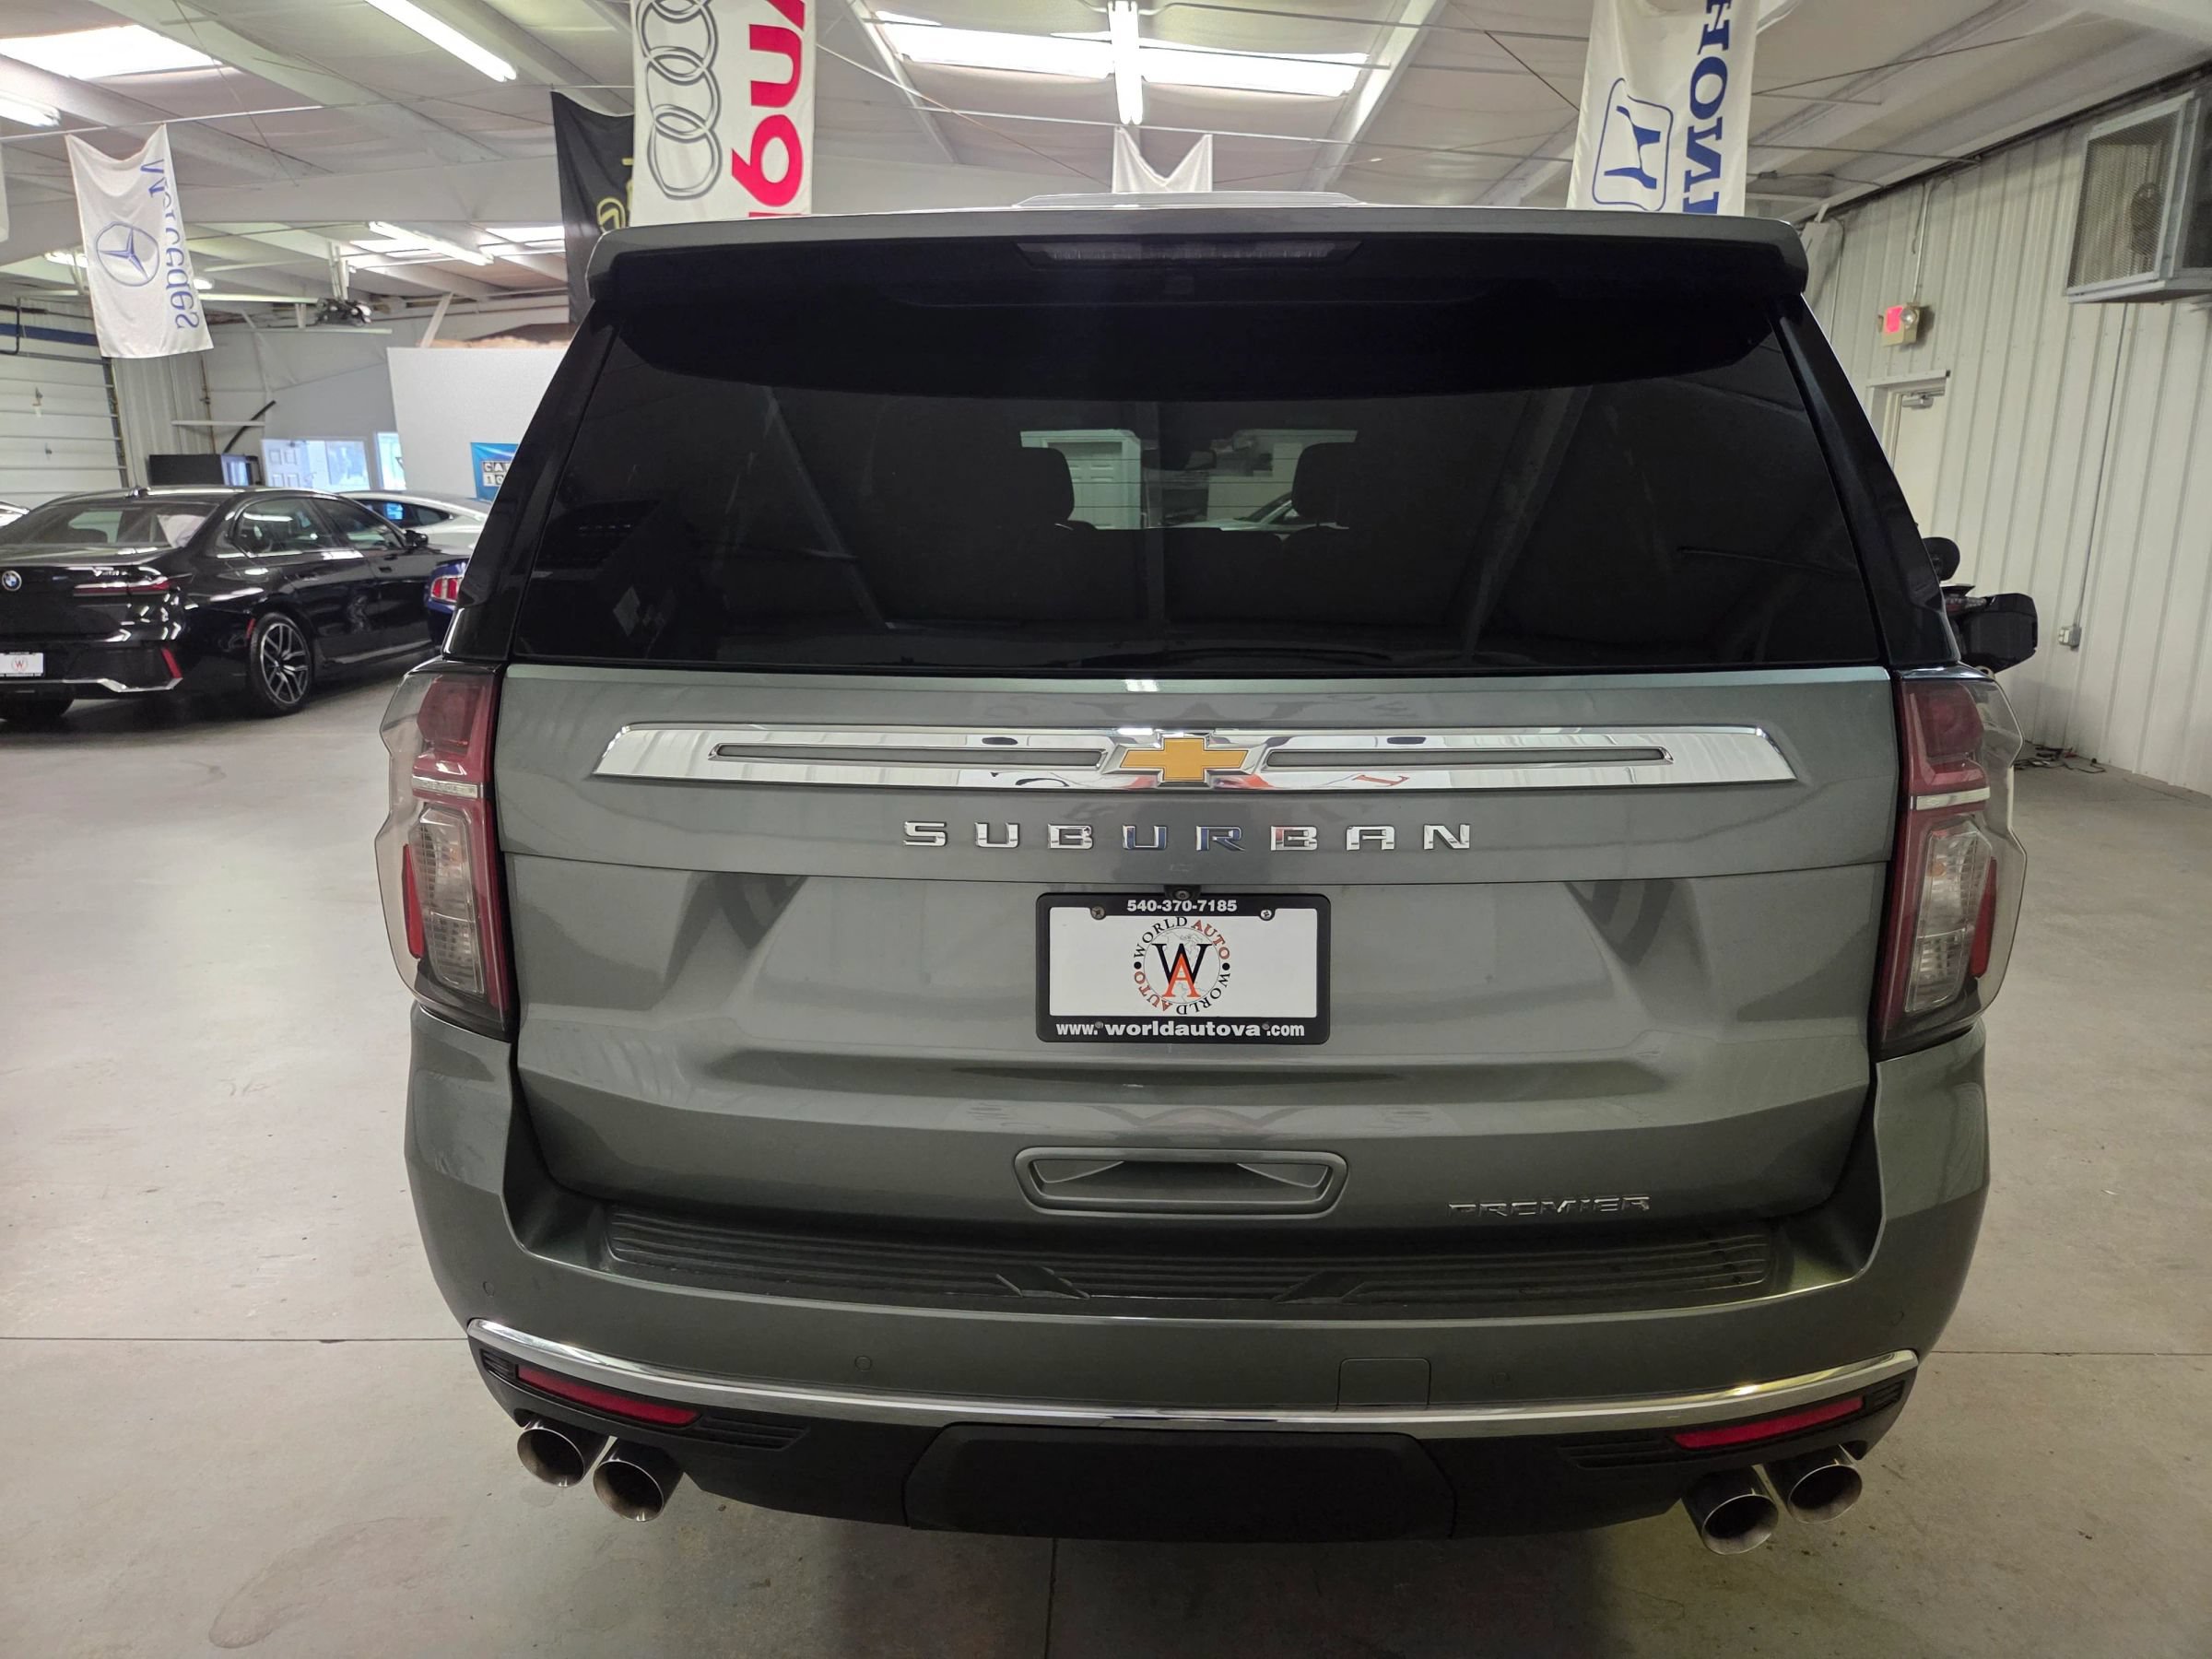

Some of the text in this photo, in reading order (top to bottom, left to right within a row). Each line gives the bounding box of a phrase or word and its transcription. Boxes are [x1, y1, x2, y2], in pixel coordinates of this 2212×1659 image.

[903, 821, 1472, 852] SUBURBAN
[1126, 900, 1238, 912] 540-370-7185
[1134, 916, 1230, 959] WORLD AUTO
[1134, 971, 1230, 1015] WORLD AUTO
[1448, 1196, 1651, 1218] PREMIER
